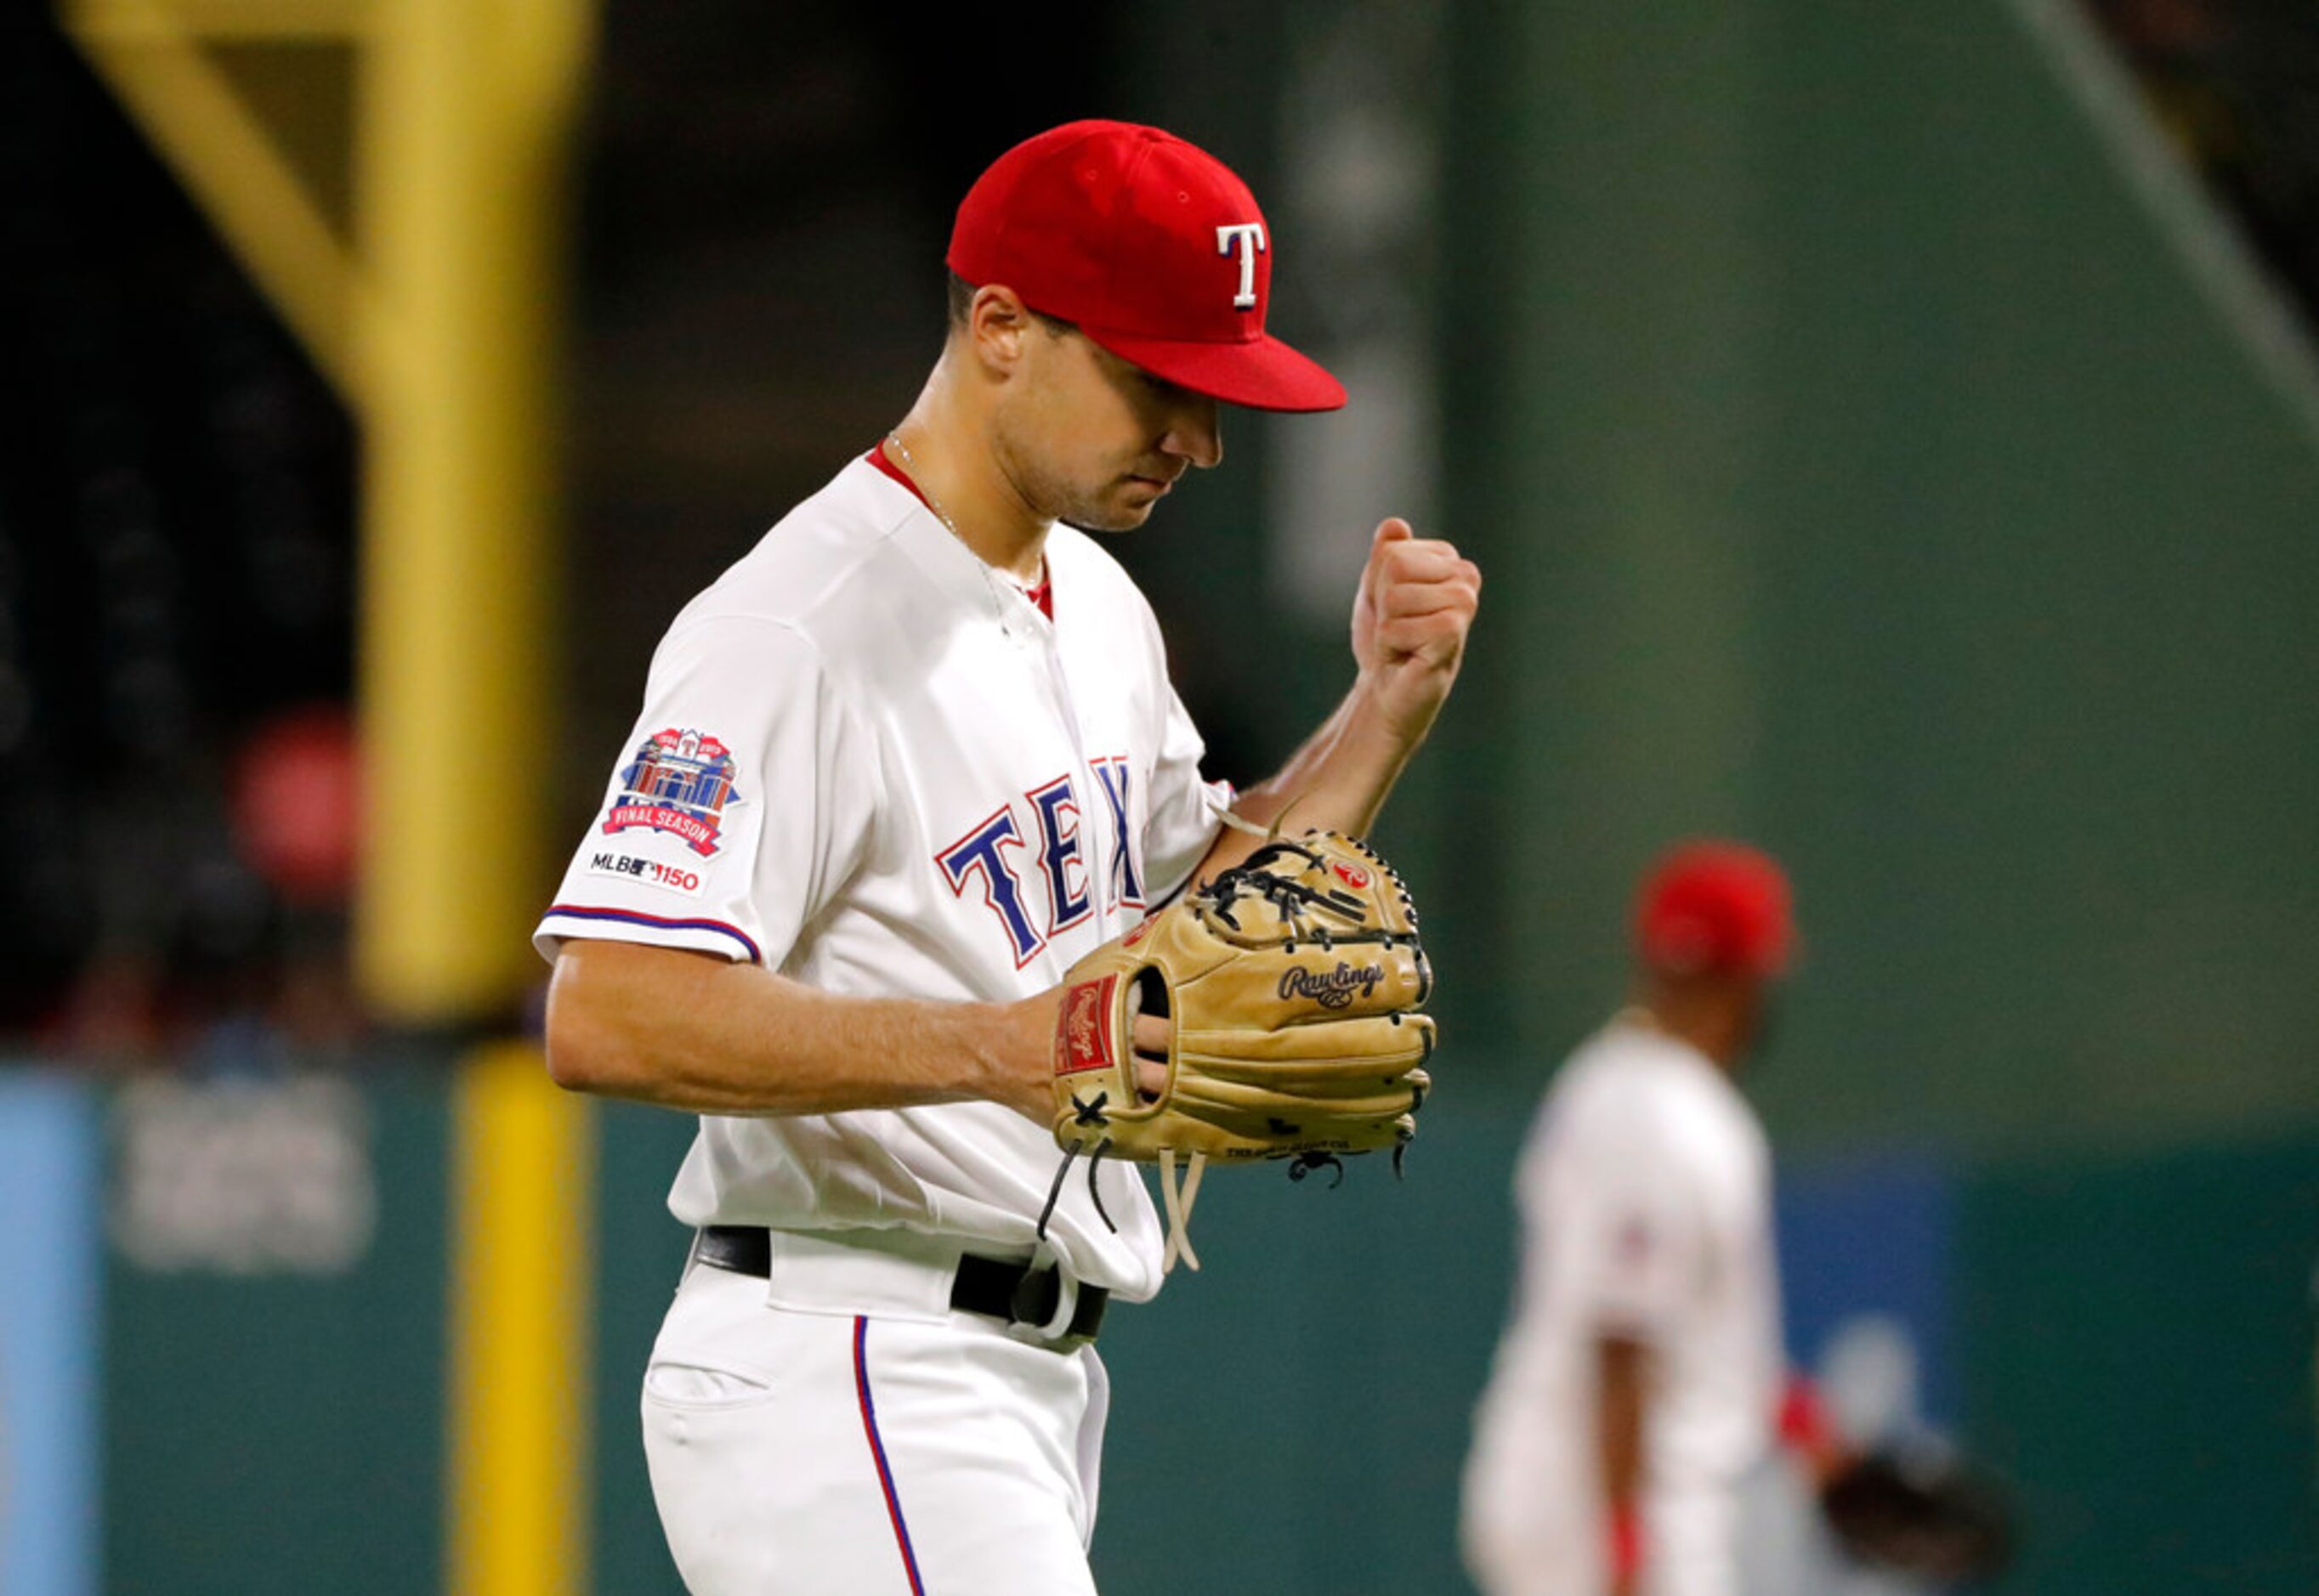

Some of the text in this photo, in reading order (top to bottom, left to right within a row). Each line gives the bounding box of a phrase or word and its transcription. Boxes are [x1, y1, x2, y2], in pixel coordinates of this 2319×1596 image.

[1216, 223, 1265, 312] T
[615, 809, 712, 844] FINAL SEASON
[590, 852, 699, 891] MLB 150
[1278, 961, 1385, 1000] Rawlings
